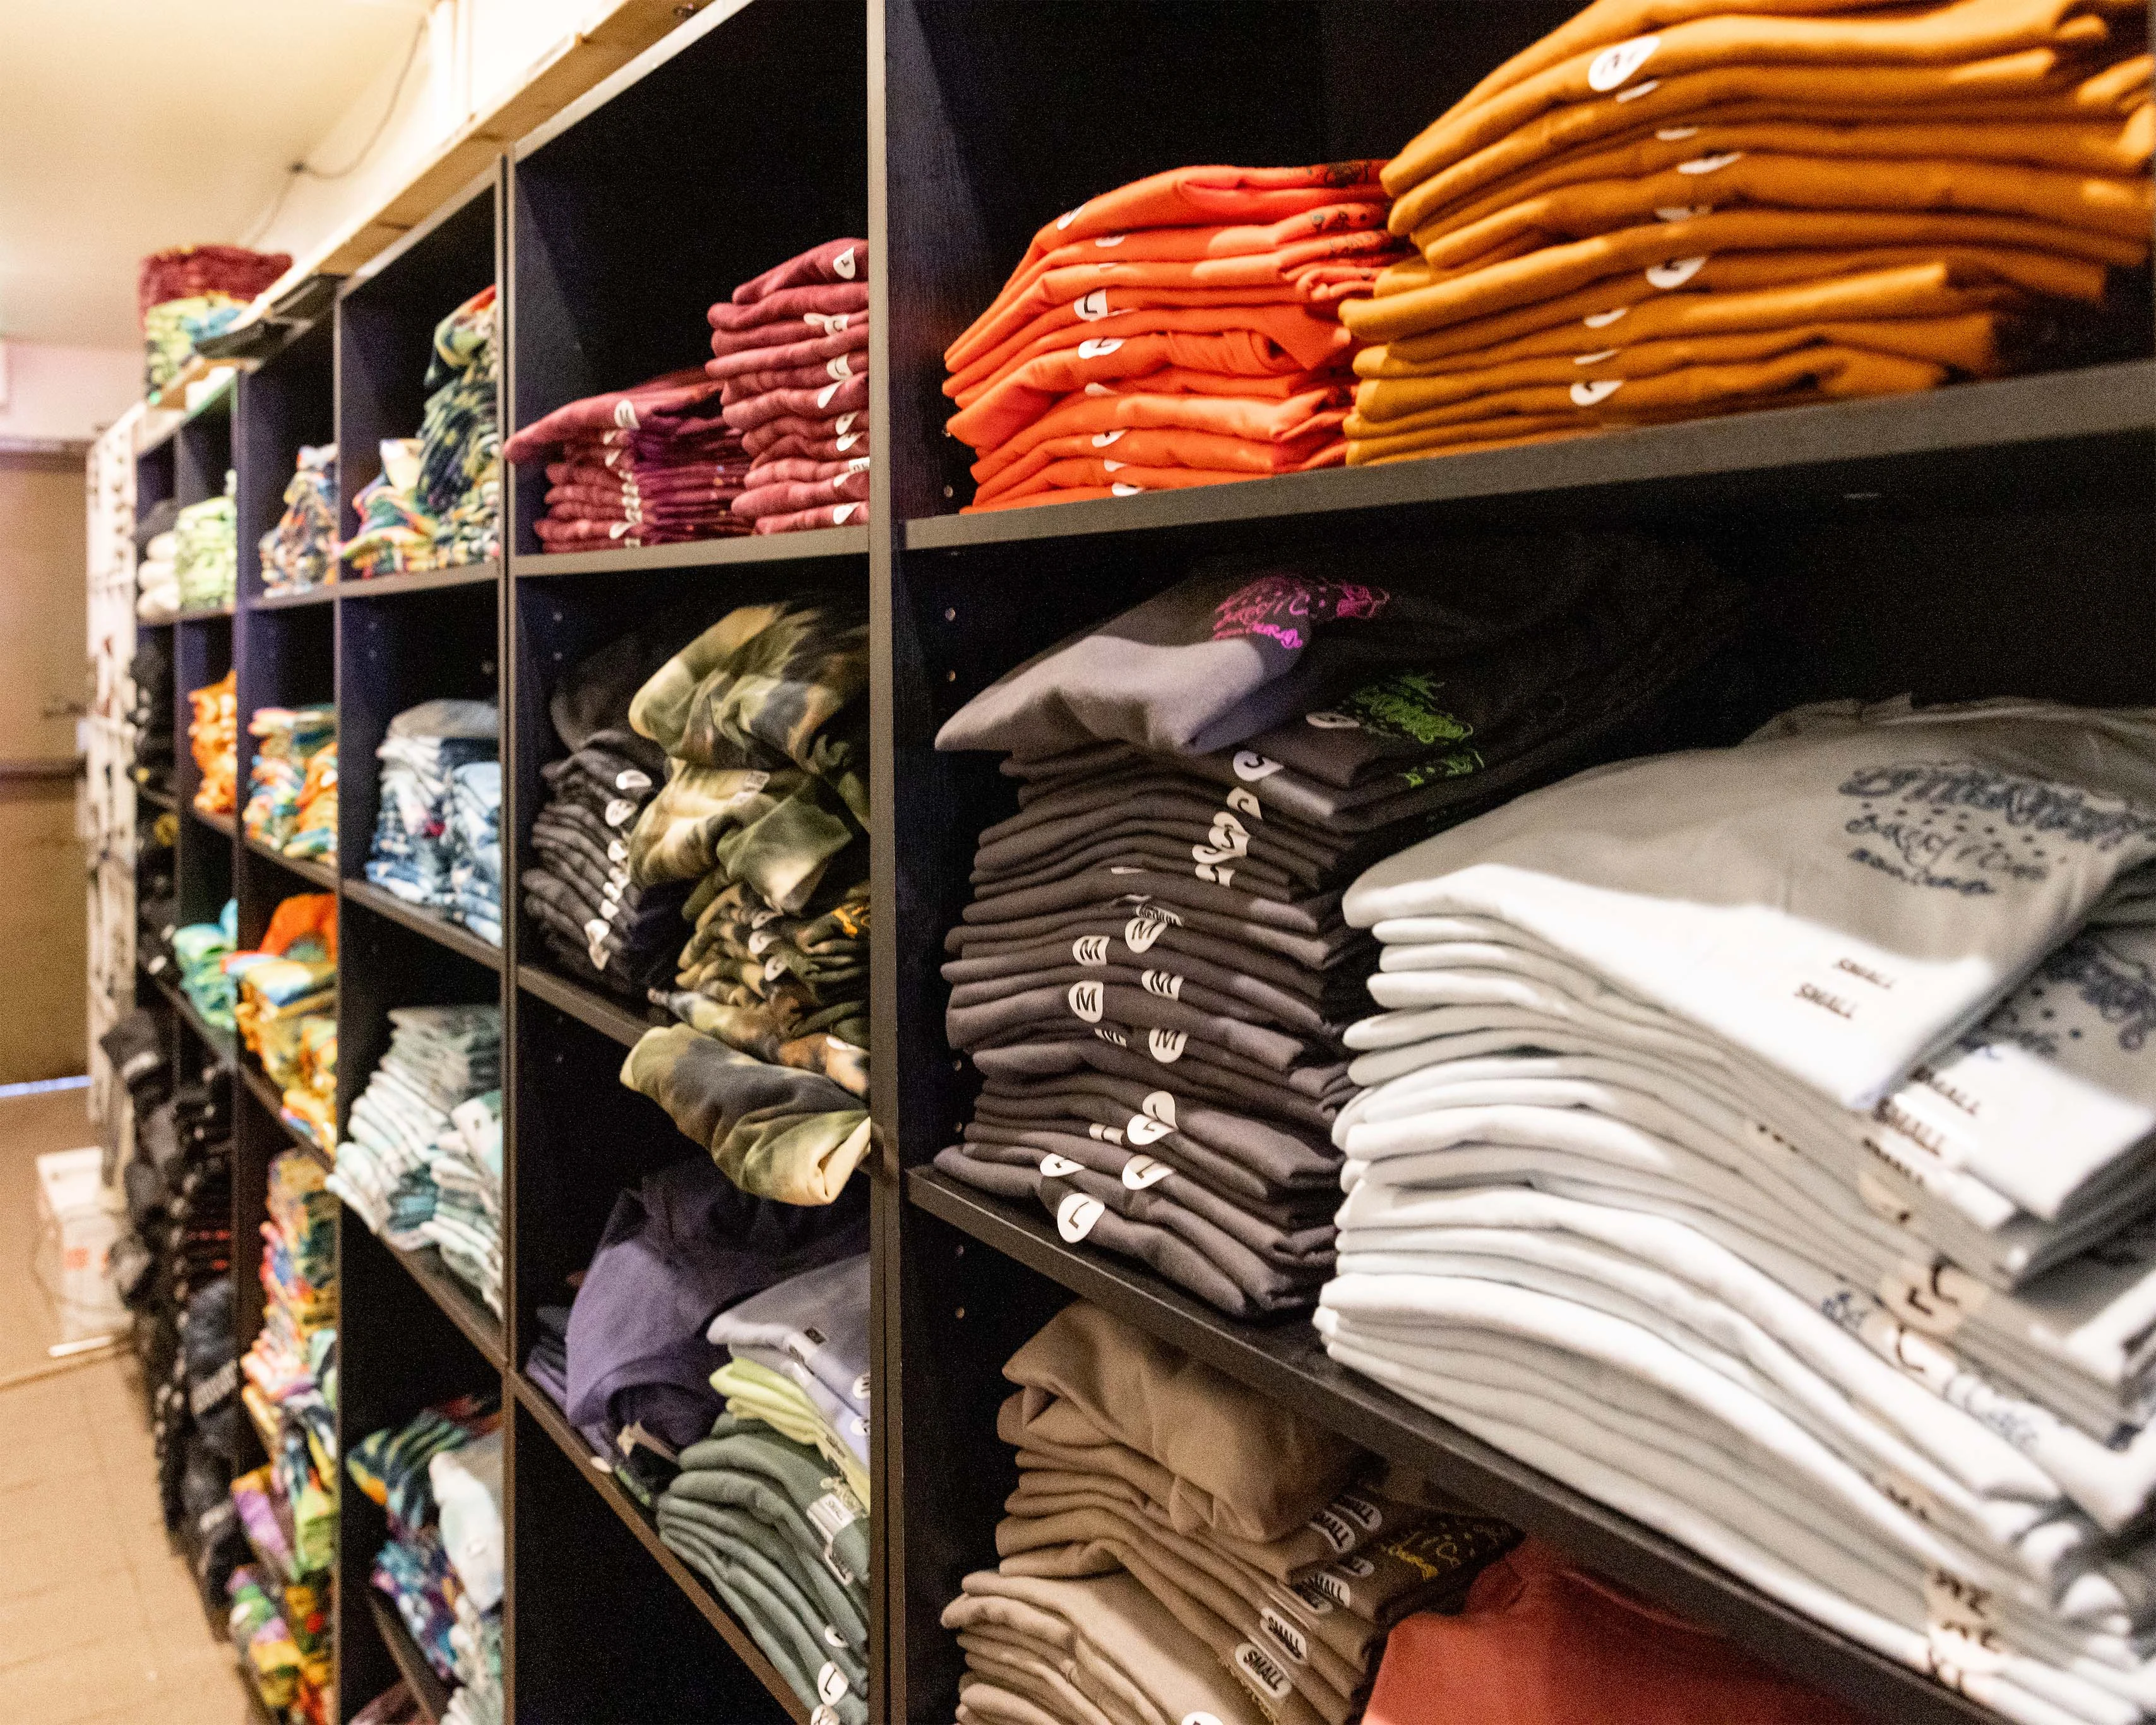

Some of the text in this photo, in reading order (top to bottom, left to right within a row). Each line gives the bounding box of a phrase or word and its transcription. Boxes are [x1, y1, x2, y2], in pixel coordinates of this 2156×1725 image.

[1084, 294, 1098, 314] L
[1132, 919, 1160, 940] M
[1080, 939, 1100, 960] M
[1150, 970, 1176, 994] M
[1076, 987, 1097, 1012] M
[1155, 1029, 1181, 1051] M
[1136, 1161, 1157, 1179] L
[1068, 1201, 1090, 1228] L
[1268, 1616, 1302, 1659] SMALL
[824, 1668, 837, 1696] L
[1242, 1649, 1284, 1691] SMALL
